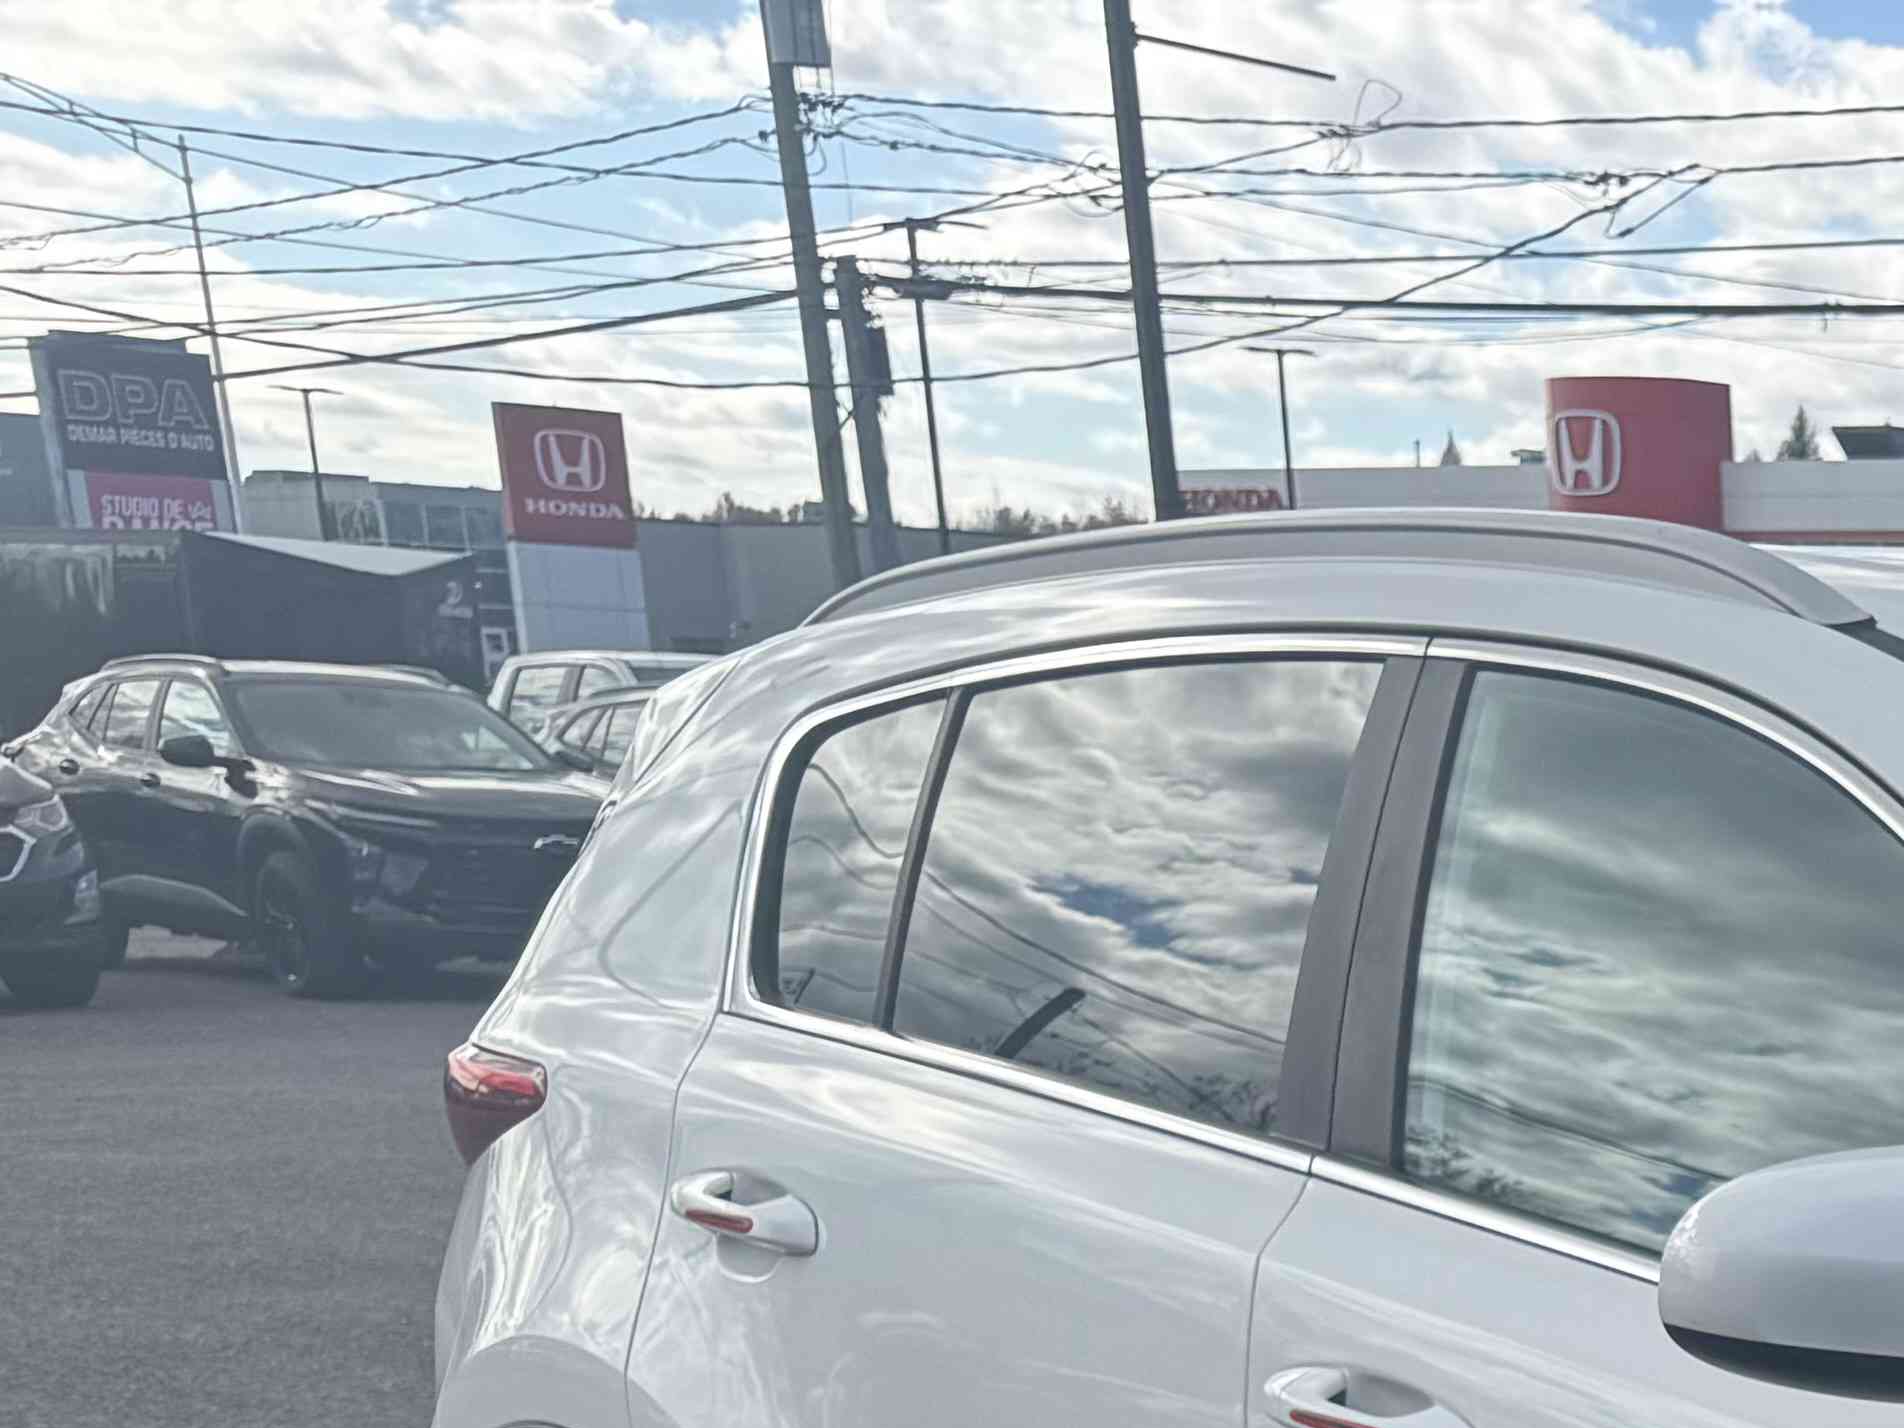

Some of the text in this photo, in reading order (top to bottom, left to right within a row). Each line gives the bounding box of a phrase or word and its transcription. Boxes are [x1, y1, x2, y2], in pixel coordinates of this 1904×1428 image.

[57, 368, 210, 431] DPA
[66, 423, 117, 444] DEMAR
[101, 494, 185, 518] STUDIO DE
[524, 497, 625, 520] HONDA
